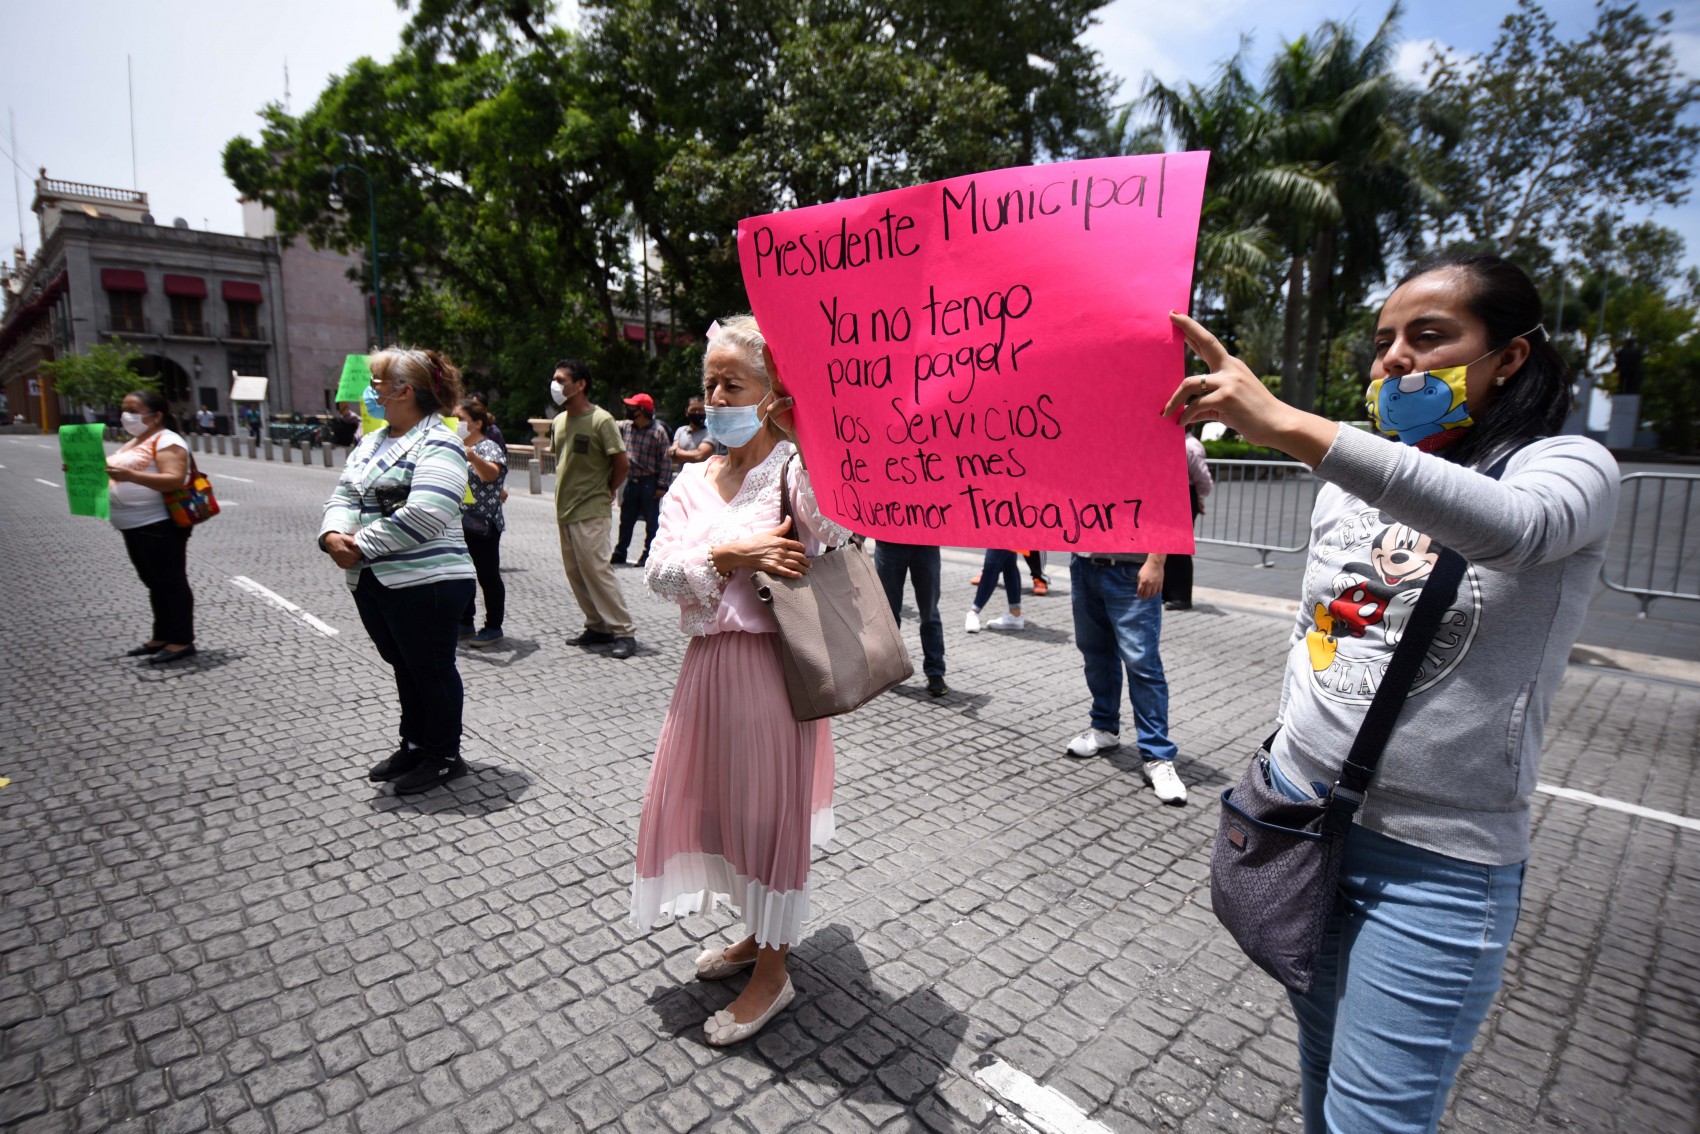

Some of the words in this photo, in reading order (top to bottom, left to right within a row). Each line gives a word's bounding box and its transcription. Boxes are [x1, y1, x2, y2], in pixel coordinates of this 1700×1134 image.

[754, 208, 920, 278] Presidente
[943, 157, 1165, 241] Municipal
[871, 307, 911, 342] no
[922, 284, 1032, 346] tengo
[827, 355, 892, 397] para
[914, 339, 1033, 405] pagar
[833, 406, 870, 444] los
[841, 449, 870, 483] de
[885, 448, 944, 484] este
[956, 448, 1026, 478] mes
